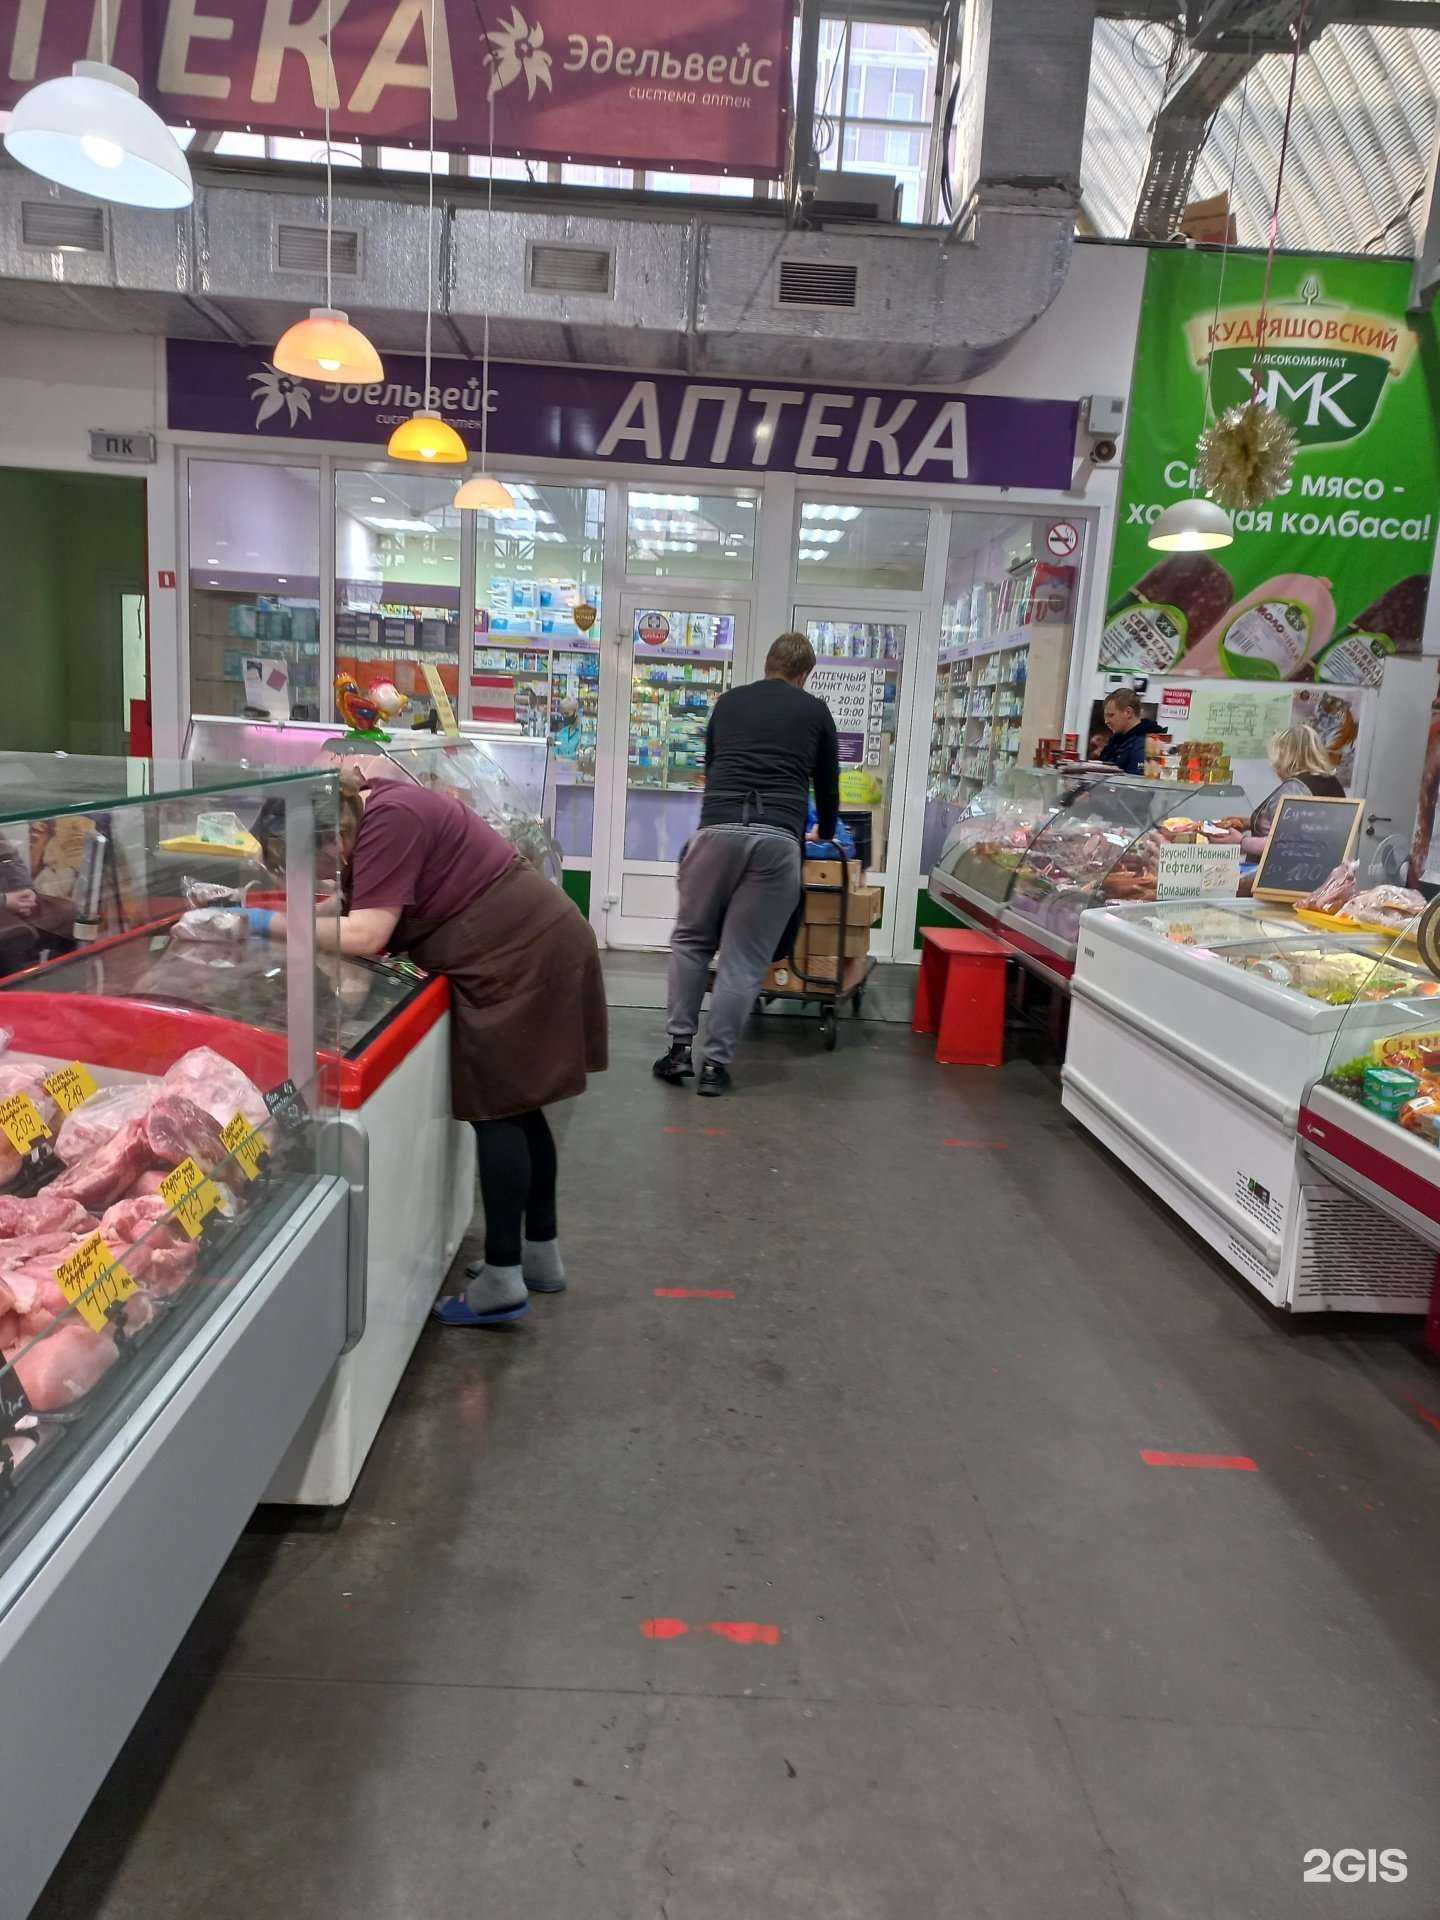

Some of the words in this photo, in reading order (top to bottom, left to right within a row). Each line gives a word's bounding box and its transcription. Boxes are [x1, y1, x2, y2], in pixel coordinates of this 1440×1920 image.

[563, 34, 773, 88] Эдельвейс
[628, 86, 696, 104] система
[702, 94, 751, 109] аптек
[1208, 318, 1399, 352] КУДРЯШОВСКИЙ
[596, 381, 969, 480] АПТЕКА
[107, 437, 133, 454] ПК
[1301, 475, 1385, 500] мясо
[1281, 510, 1432, 541] колбаса!
[811, 671, 867, 682] АПТЕЧНЫЙ
[811, 681, 842, 691] ПУНКТ
[838, 695, 865, 705] 20:00
[838, 707, 864, 717] 19:00
[1160, 861, 1203, 876] Тефтели
[1158, 883, 1201, 901] Домашние
[11, 1113, 36, 1142] 209
